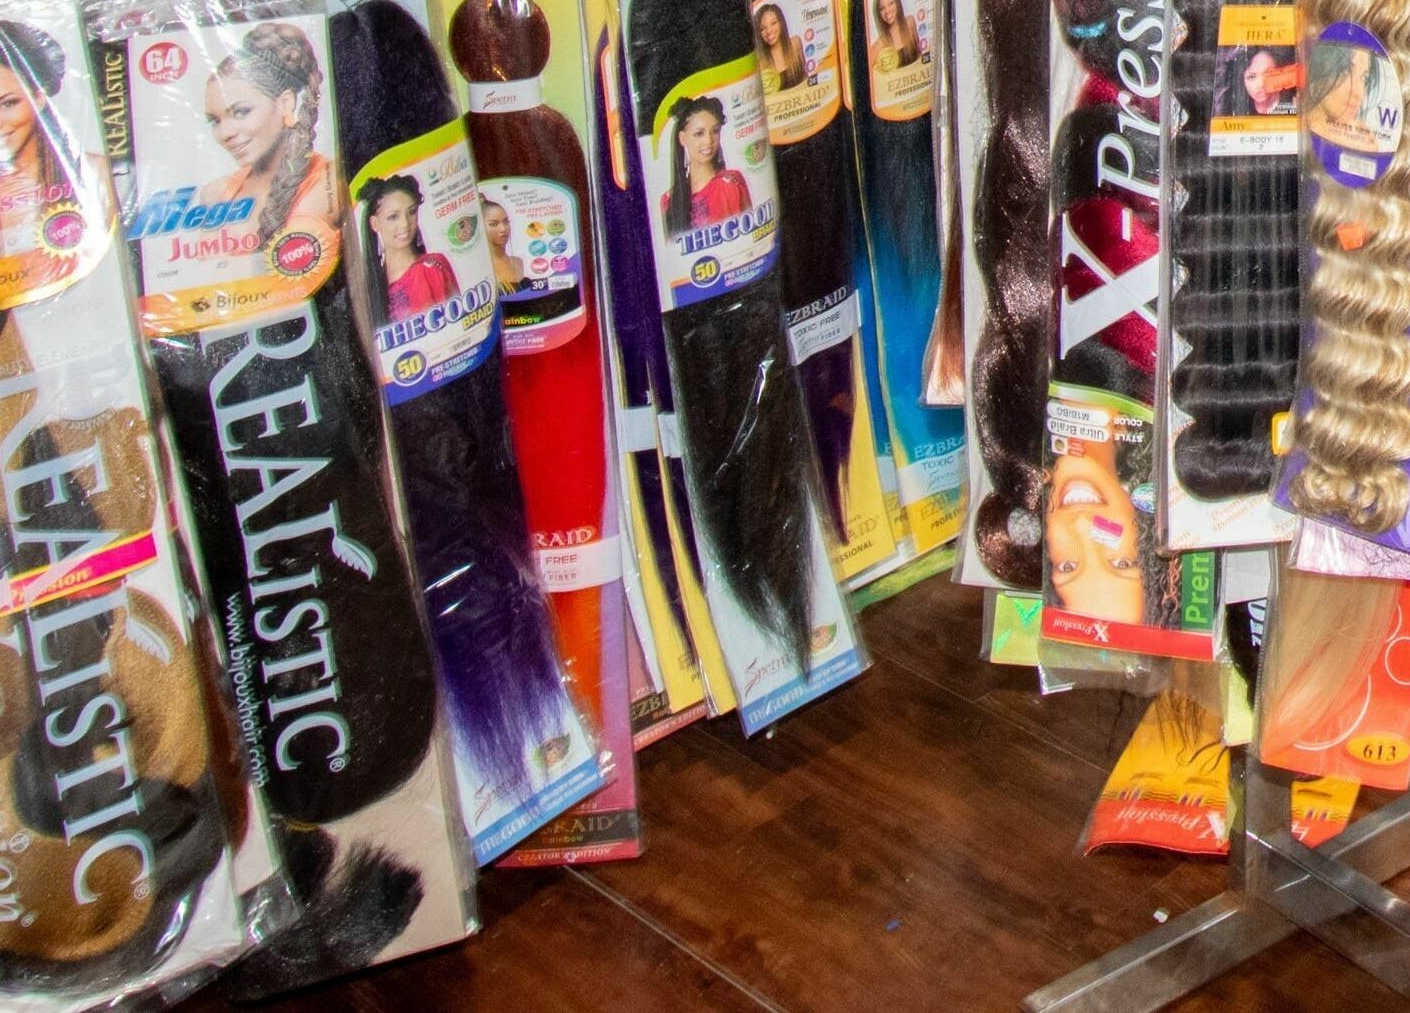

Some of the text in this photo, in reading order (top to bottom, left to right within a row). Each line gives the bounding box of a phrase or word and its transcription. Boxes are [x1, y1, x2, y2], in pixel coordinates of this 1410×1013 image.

[145, 45, 182, 72] 64
[100, 52, 125, 159] REALISTIC
[774, 101, 822, 123] PROFESSIONAL
[127, 186, 255, 241] Mega
[435, 191, 477, 220] GERM FREE
[675, 199, 776, 256] THEGOOD
[168, 227, 260, 264] Jumbo
[281, 244, 314, 264] 100%
[694, 263, 717, 280] 50
[215, 291, 269, 309] Bijoux
[375, 278, 494, 354] THEGOOD BRAID
[819, 311, 841, 328] FREE
[396, 353, 422, 377] 50
[1050, 420, 1144, 444] STYLE Ultra Braid
[1113, 416, 1143, 427] COLOR
[921, 456, 955, 471] TOXIC
[201, 303, 352, 776] REALISTIC
[545, 554, 577, 565] FREE
[1052, 618, 1109, 643] X-Pression
[226, 590, 270, 790] www.bijouxhair.com
[1362, 742, 1398, 762] 613
